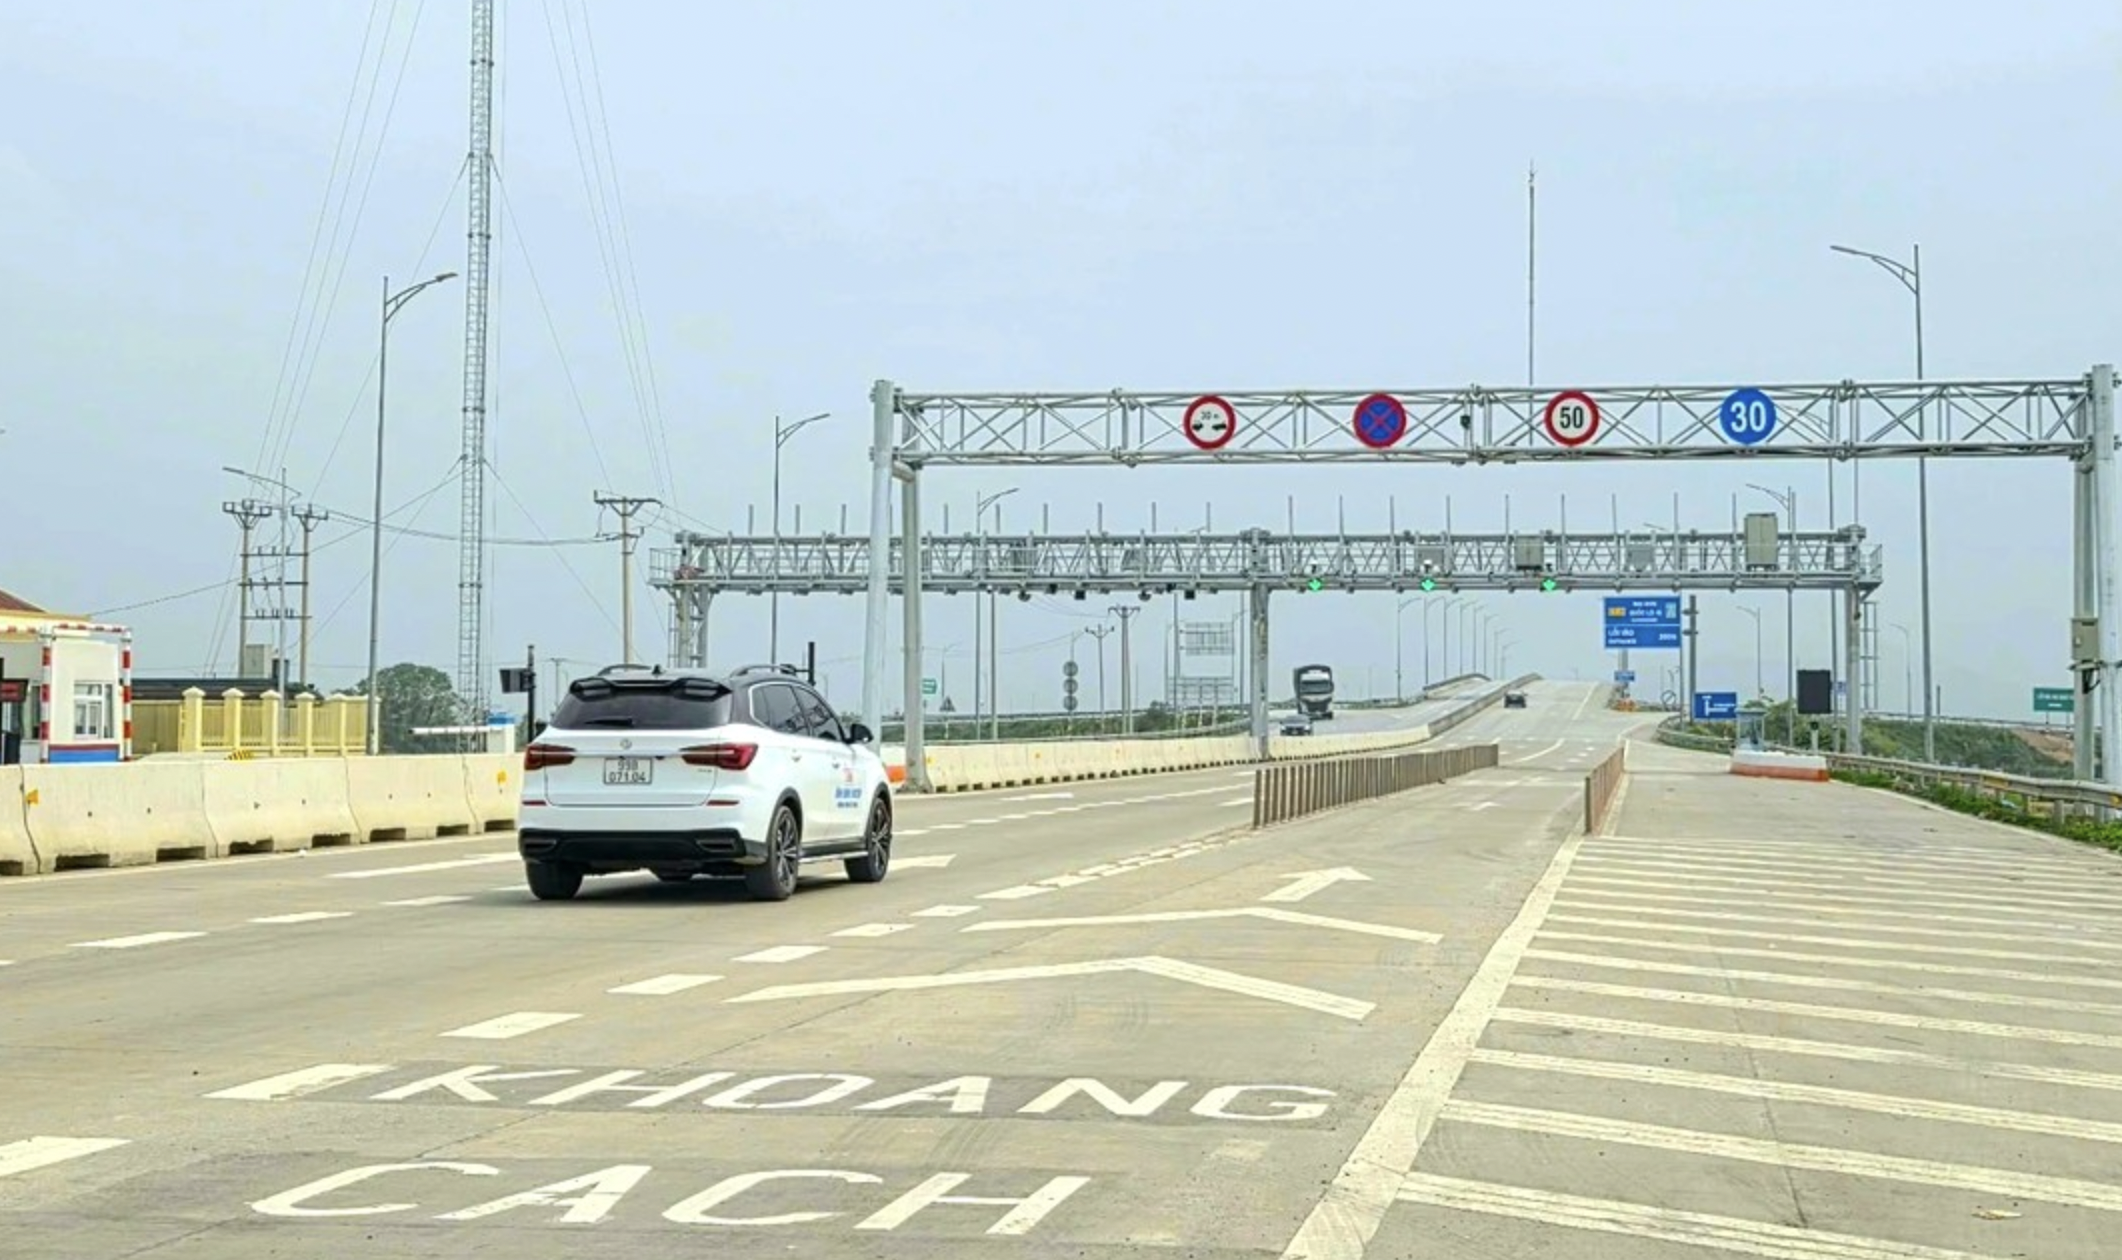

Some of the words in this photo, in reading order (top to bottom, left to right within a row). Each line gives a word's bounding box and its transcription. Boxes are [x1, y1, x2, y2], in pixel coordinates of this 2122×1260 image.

[1560, 406, 1583, 429] 50
[1731, 401, 1766, 433] 30
[370, 1064, 1338, 1121] KHOANG
[251, 1161, 1091, 1235] CACH
